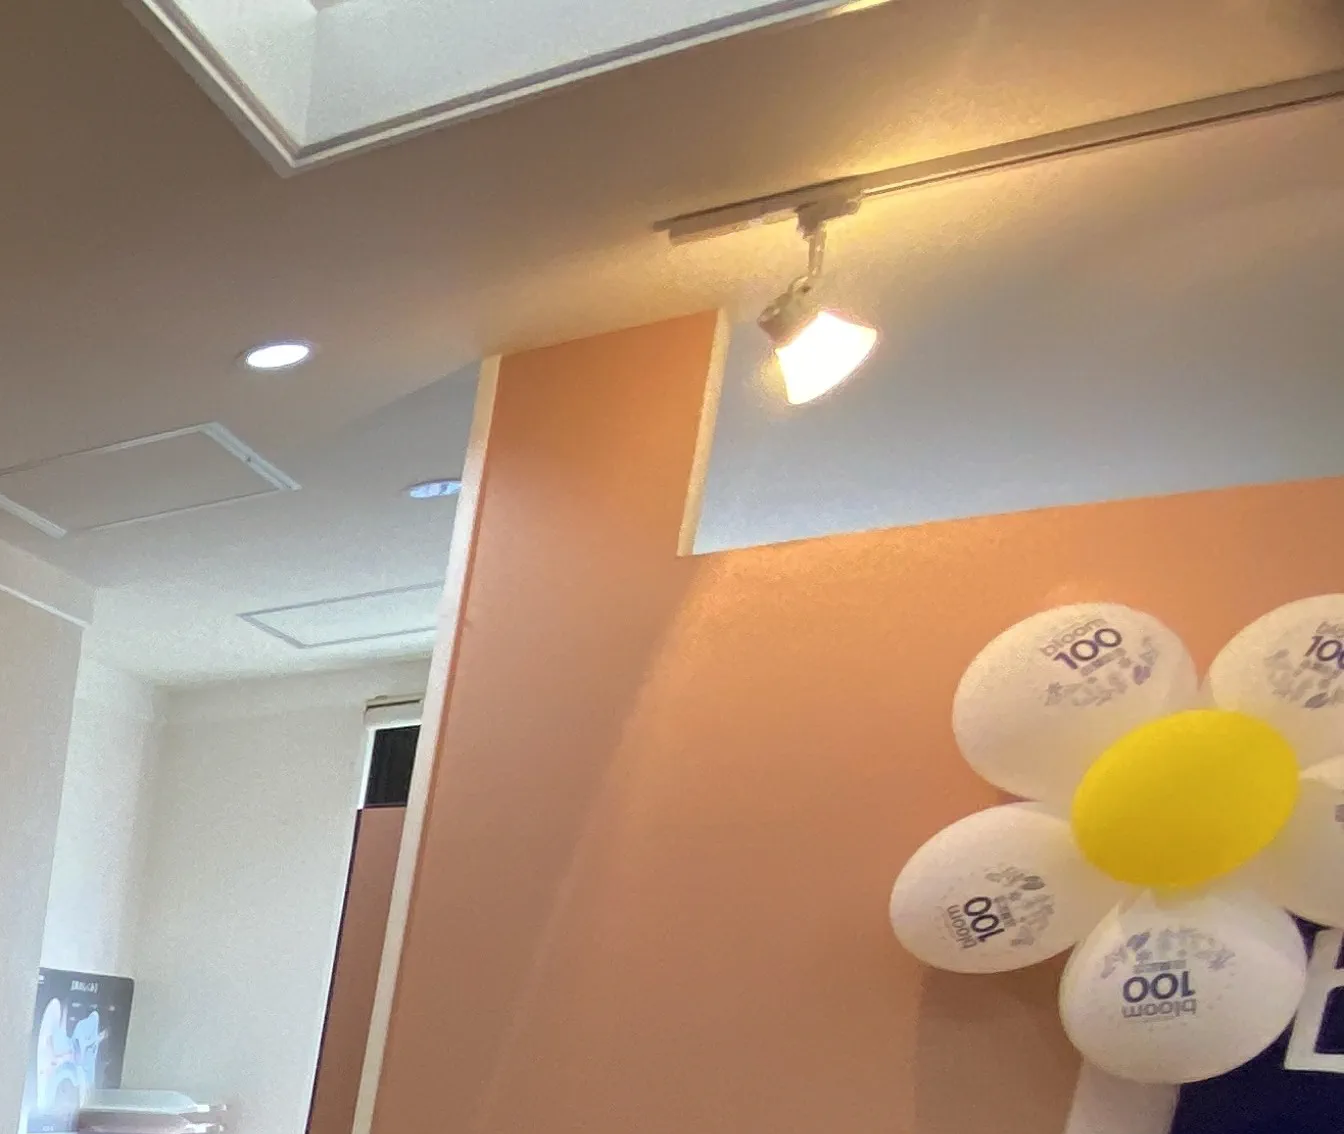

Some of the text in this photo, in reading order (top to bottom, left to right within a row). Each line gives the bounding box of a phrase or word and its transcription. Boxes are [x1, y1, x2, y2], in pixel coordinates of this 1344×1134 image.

[1039, 619, 1108, 656] bloom
[1053, 628, 1122, 669] 100
[947, 904, 977, 949] bloom
[964, 897, 1004, 942] 100
[1123, 971, 1195, 1003] 100
[1122, 999, 1196, 1018] bloom
